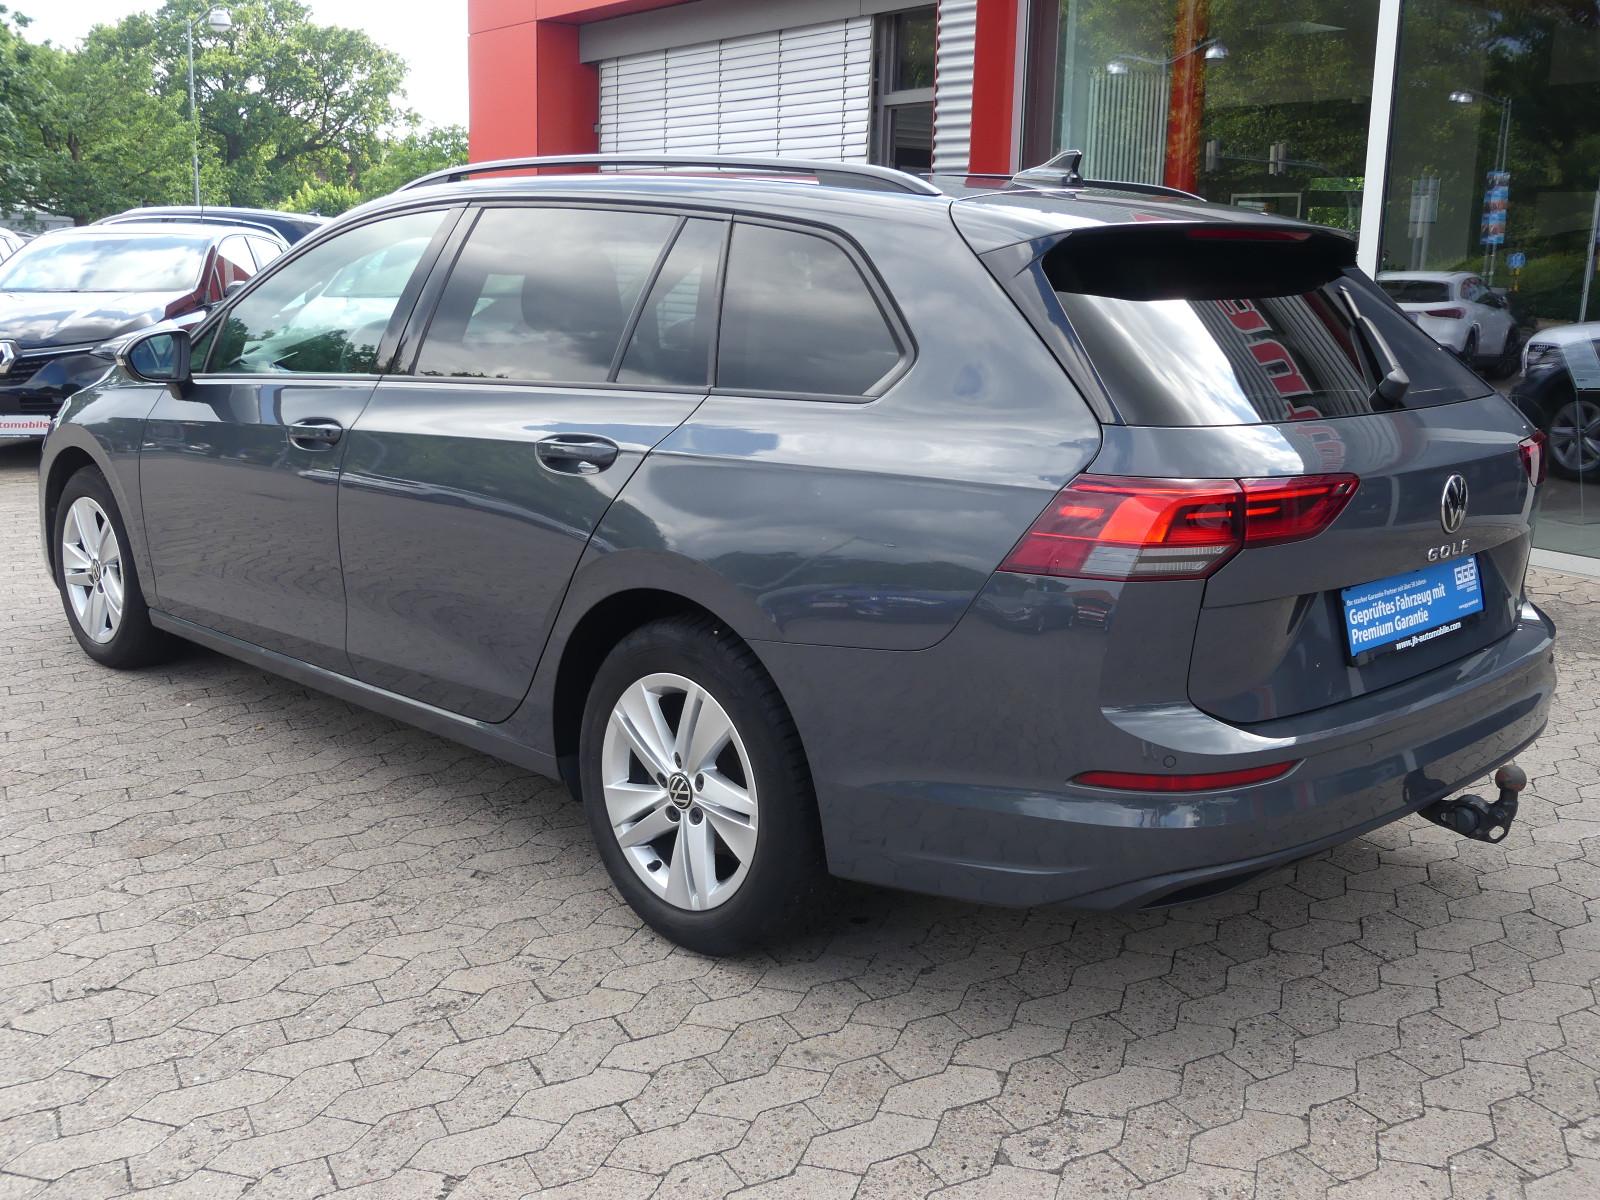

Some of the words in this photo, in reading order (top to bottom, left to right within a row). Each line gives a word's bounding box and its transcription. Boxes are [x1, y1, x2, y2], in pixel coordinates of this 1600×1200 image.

[1427, 538, 1471, 562] GOLF
[1349, 600, 1395, 625] Geprüftes
[1395, 593, 1432, 612] Fahrzeug
[1431, 582, 1446, 600] mit
[1351, 621, 1394, 645] Premium
[1394, 607, 1429, 631] Garantie
